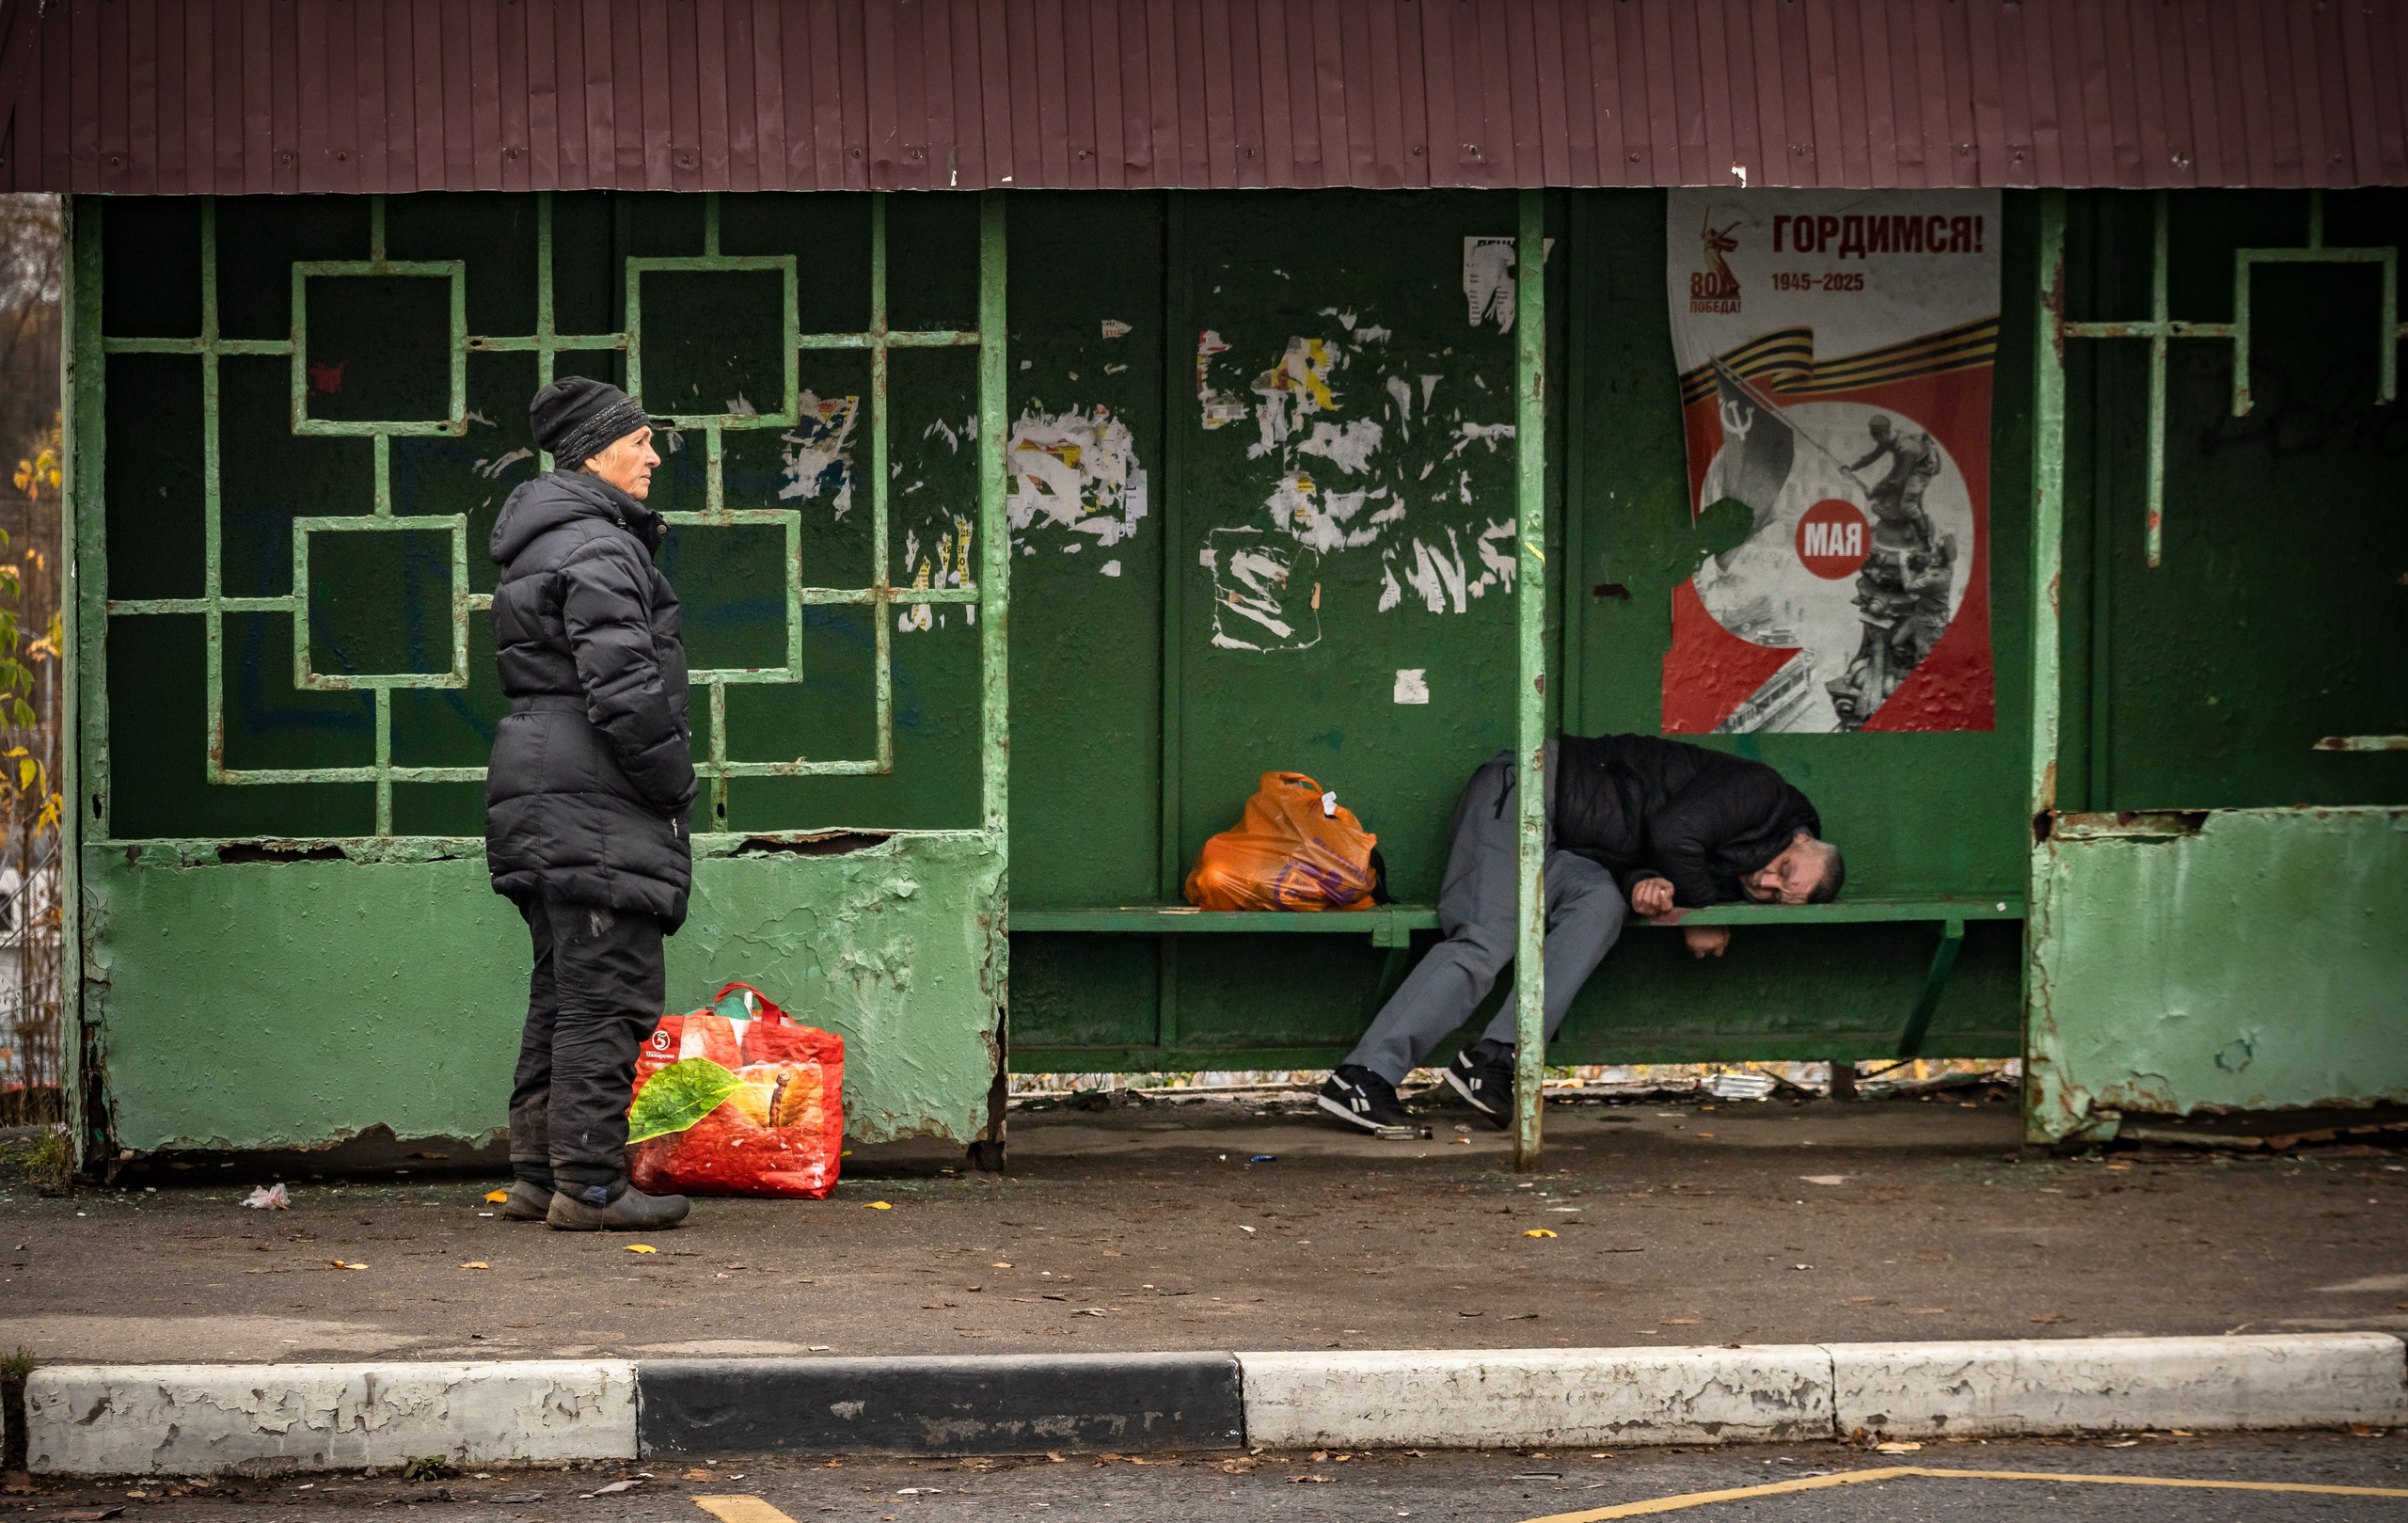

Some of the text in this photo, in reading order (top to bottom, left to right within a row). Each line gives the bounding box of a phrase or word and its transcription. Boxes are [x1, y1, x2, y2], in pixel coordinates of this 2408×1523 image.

[1773, 215, 1983, 259] ГОРДИМСЯ!
[1690, 272, 1719, 296] 80
[1690, 301, 1741, 315] ПОБЕДА!
[1804, 522, 1861, 557] МАЯ
